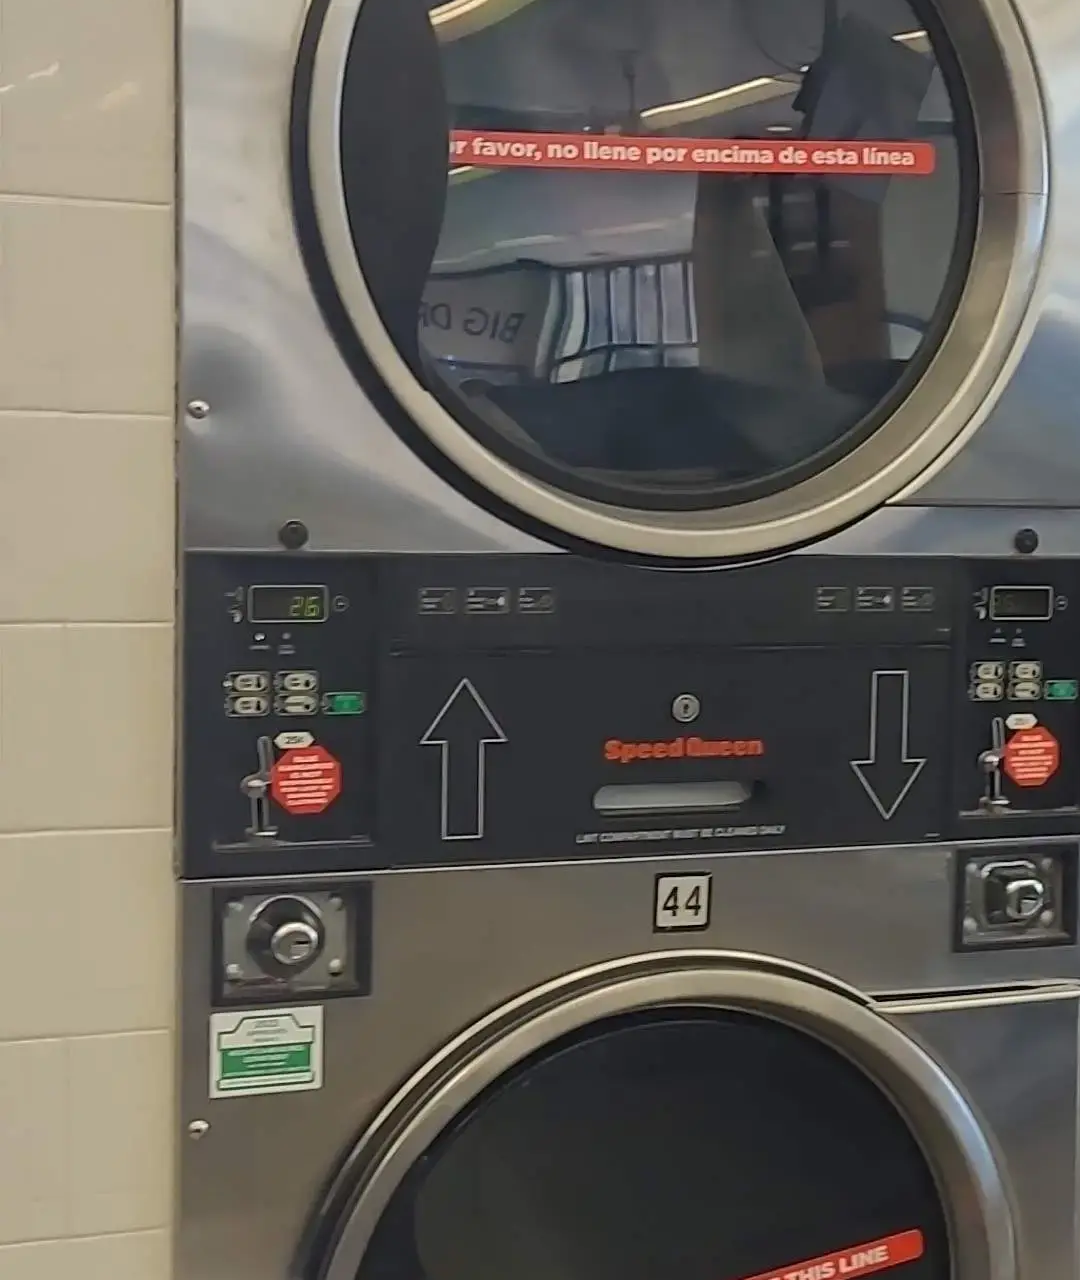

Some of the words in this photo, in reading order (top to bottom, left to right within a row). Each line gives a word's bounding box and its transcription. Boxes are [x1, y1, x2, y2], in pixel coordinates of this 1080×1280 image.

[472, 137, 543, 161] favor,
[547, 143, 579, 159] no
[583, 141, 642, 161] llene
[646, 146, 689, 165] por
[692, 146, 774, 164] encima
[778, 146, 808, 164] de
[812, 148, 858, 165] esta
[863, 147, 916, 166] línea
[289, 595, 320, 617] 26
[605, 736, 684, 763] Speed
[662, 885, 701, 917] 44
[839, 1245, 889, 1274] LINE
